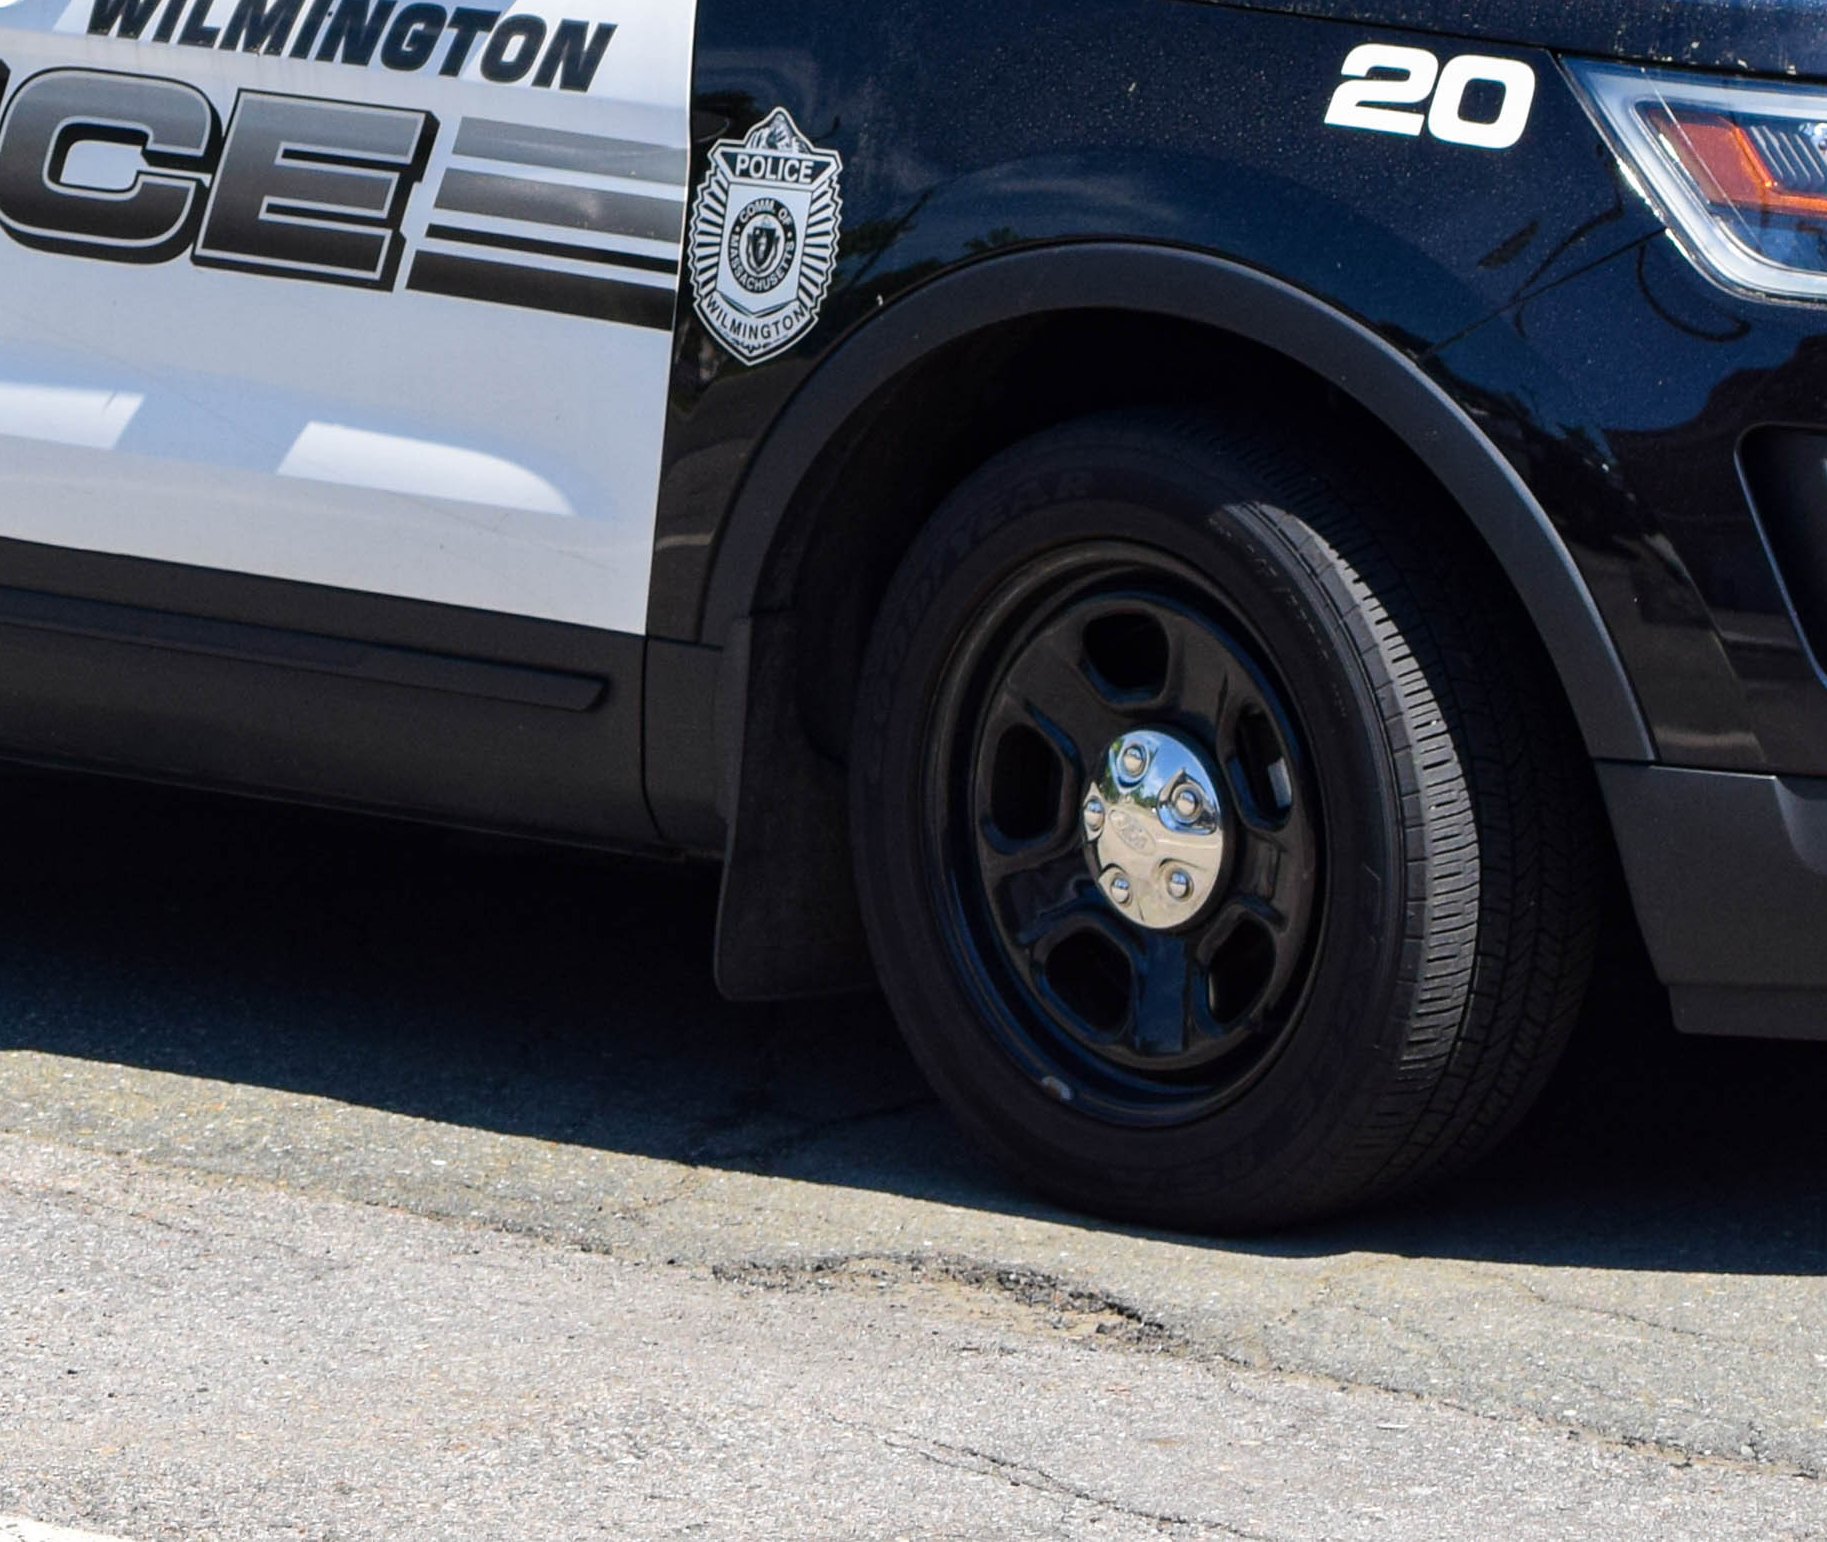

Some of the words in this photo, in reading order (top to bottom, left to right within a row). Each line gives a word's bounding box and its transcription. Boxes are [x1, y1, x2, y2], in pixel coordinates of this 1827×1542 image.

[1324, 43, 1536, 150] 20
[734, 153, 815, 184] POLICE
[778, 208, 792, 226] OF
[729, 234, 795, 292] MASSACHUSETTS
[706, 295, 809, 341] WILMINGTON
